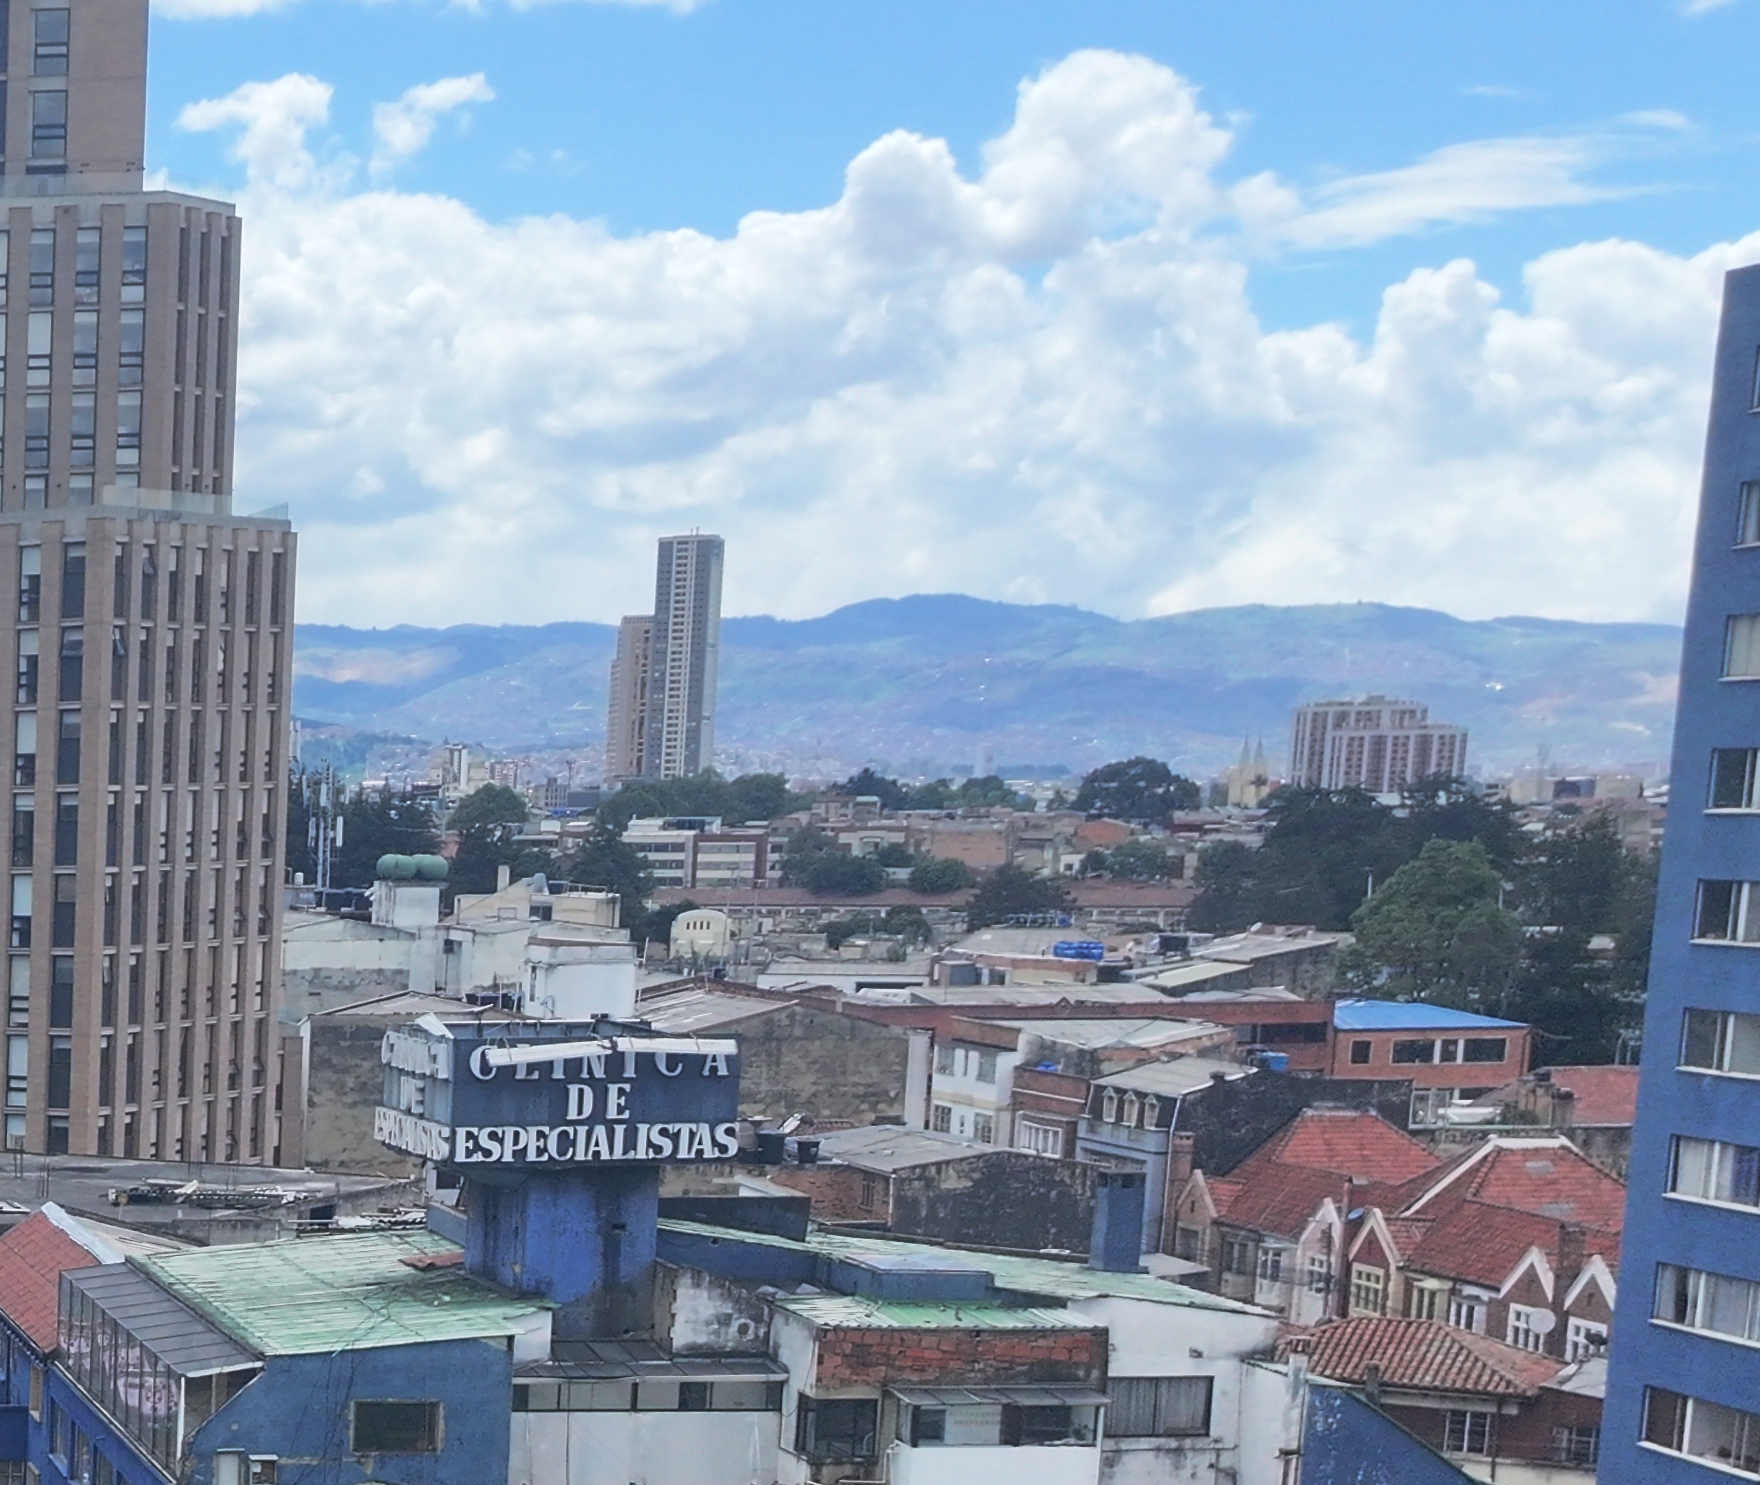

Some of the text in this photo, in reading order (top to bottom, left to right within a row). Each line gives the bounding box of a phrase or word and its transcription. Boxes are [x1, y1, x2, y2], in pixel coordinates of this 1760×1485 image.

[470, 1044, 729, 1080] CLINICA
[567, 1084, 630, 1120] DE
[454, 1122, 740, 1163] ESPECIALISTAS
